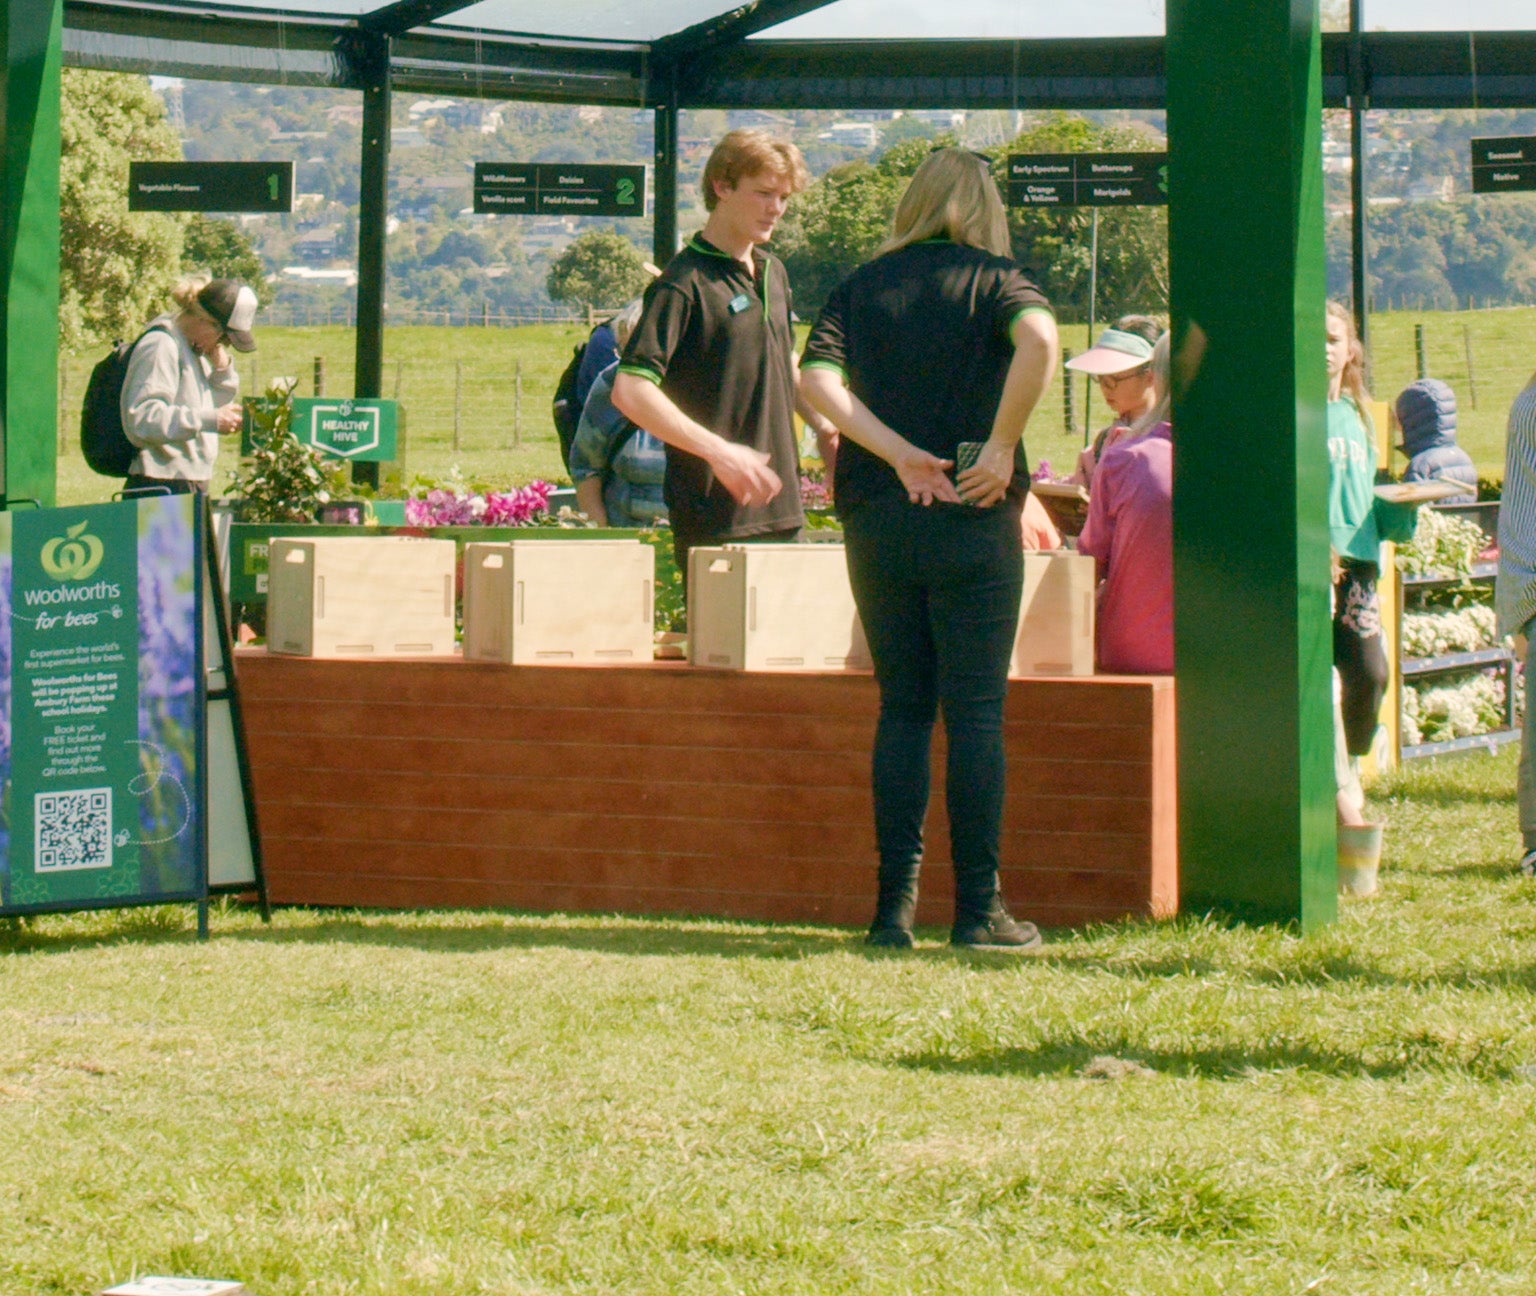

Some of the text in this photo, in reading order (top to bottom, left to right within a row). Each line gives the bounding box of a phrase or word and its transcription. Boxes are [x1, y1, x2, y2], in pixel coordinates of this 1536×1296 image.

[1013, 165, 1070, 175] Early Spectrum
[1092, 165, 1133, 174] Buttercups
[1493, 173, 1520, 181] Native
[267, 173, 279, 200] 1
[616, 177, 636, 205] 2
[1027, 185, 1056, 194] Orange
[1094, 188, 1131, 197] Marigolds
[543, 196, 599, 205] Field Favourites
[322, 420, 370, 430] HEALTHY
[333, 432, 358, 442] HIVE
[250, 544, 268, 557] FR
[25, 581, 120, 606] Woolworths
[35, 609, 98, 631] for bees
[30, 642, 120, 658] Experience the world's
[24, 653, 125, 669] first supermarket for bees.
[32, 672, 118, 686] Woolworths for Bees
[32, 682, 118, 697] will be popping up at
[35, 693, 115, 708] Ambury Farm these
[41, 704, 108, 717] school holidays.
[54, 724, 96, 736] Book your
[43, 732, 106, 746] FREE ticket and
[48, 745, 102, 756] find out more
[51, 756, 83, 766] through
[42, 765, 107, 777] QR code below.
